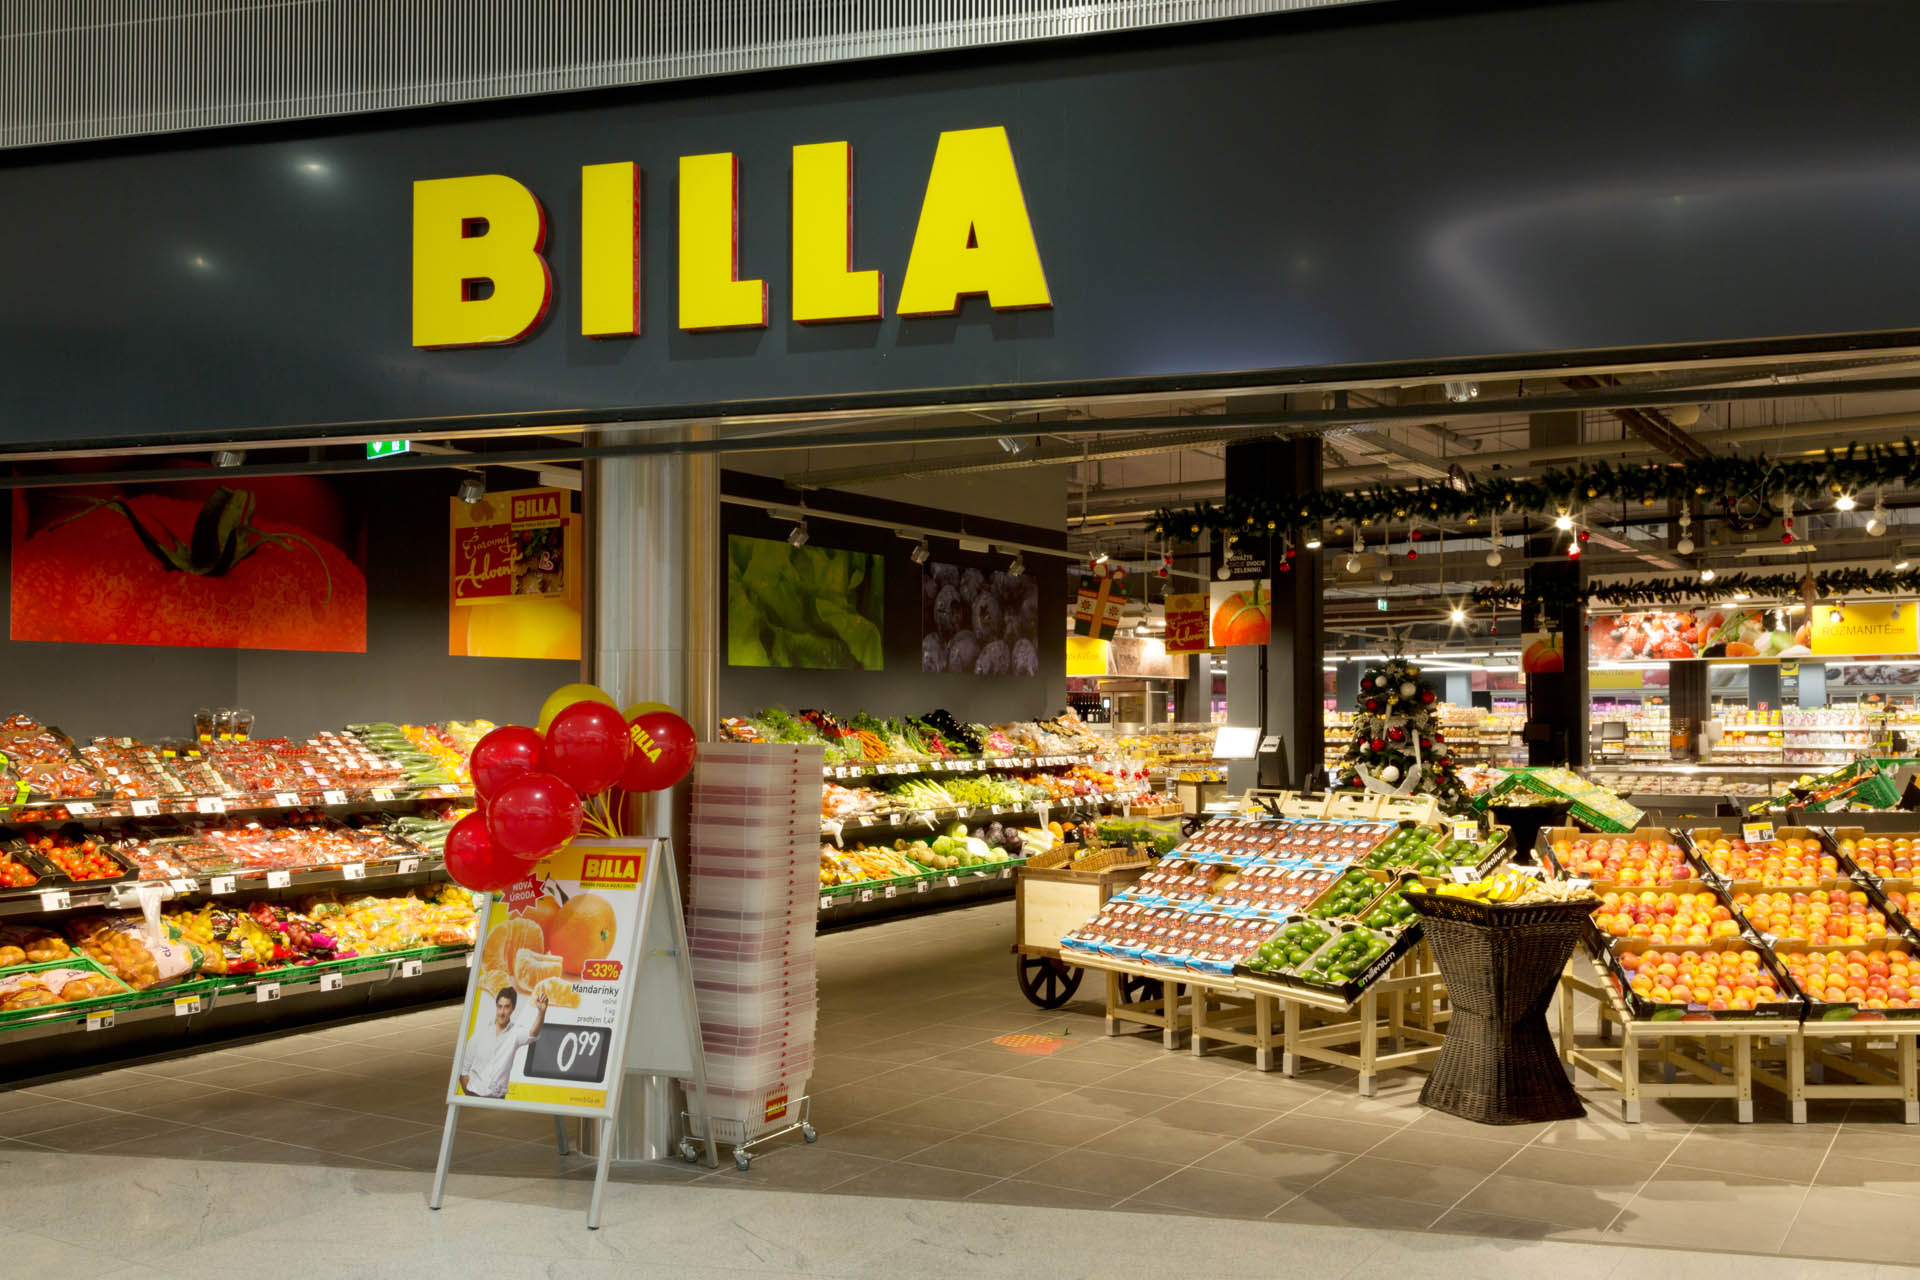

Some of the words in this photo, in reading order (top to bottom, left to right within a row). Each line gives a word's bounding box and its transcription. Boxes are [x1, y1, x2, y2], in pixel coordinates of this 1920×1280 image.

[412, 126, 1054, 350] BILLA
[514, 496, 558, 519] BILLA
[455, 548, 524, 598] Advent
[630, 723, 663, 763] BILLA
[585, 858, 635, 879] BILLA
[509, 889, 536, 902] ÚRODA
[512, 879, 533, 891] NOVÁ
[586, 963, 619, 978] -33%
[1362, 951, 1396, 985] millenium
[572, 984, 619, 997] Mandarinky
